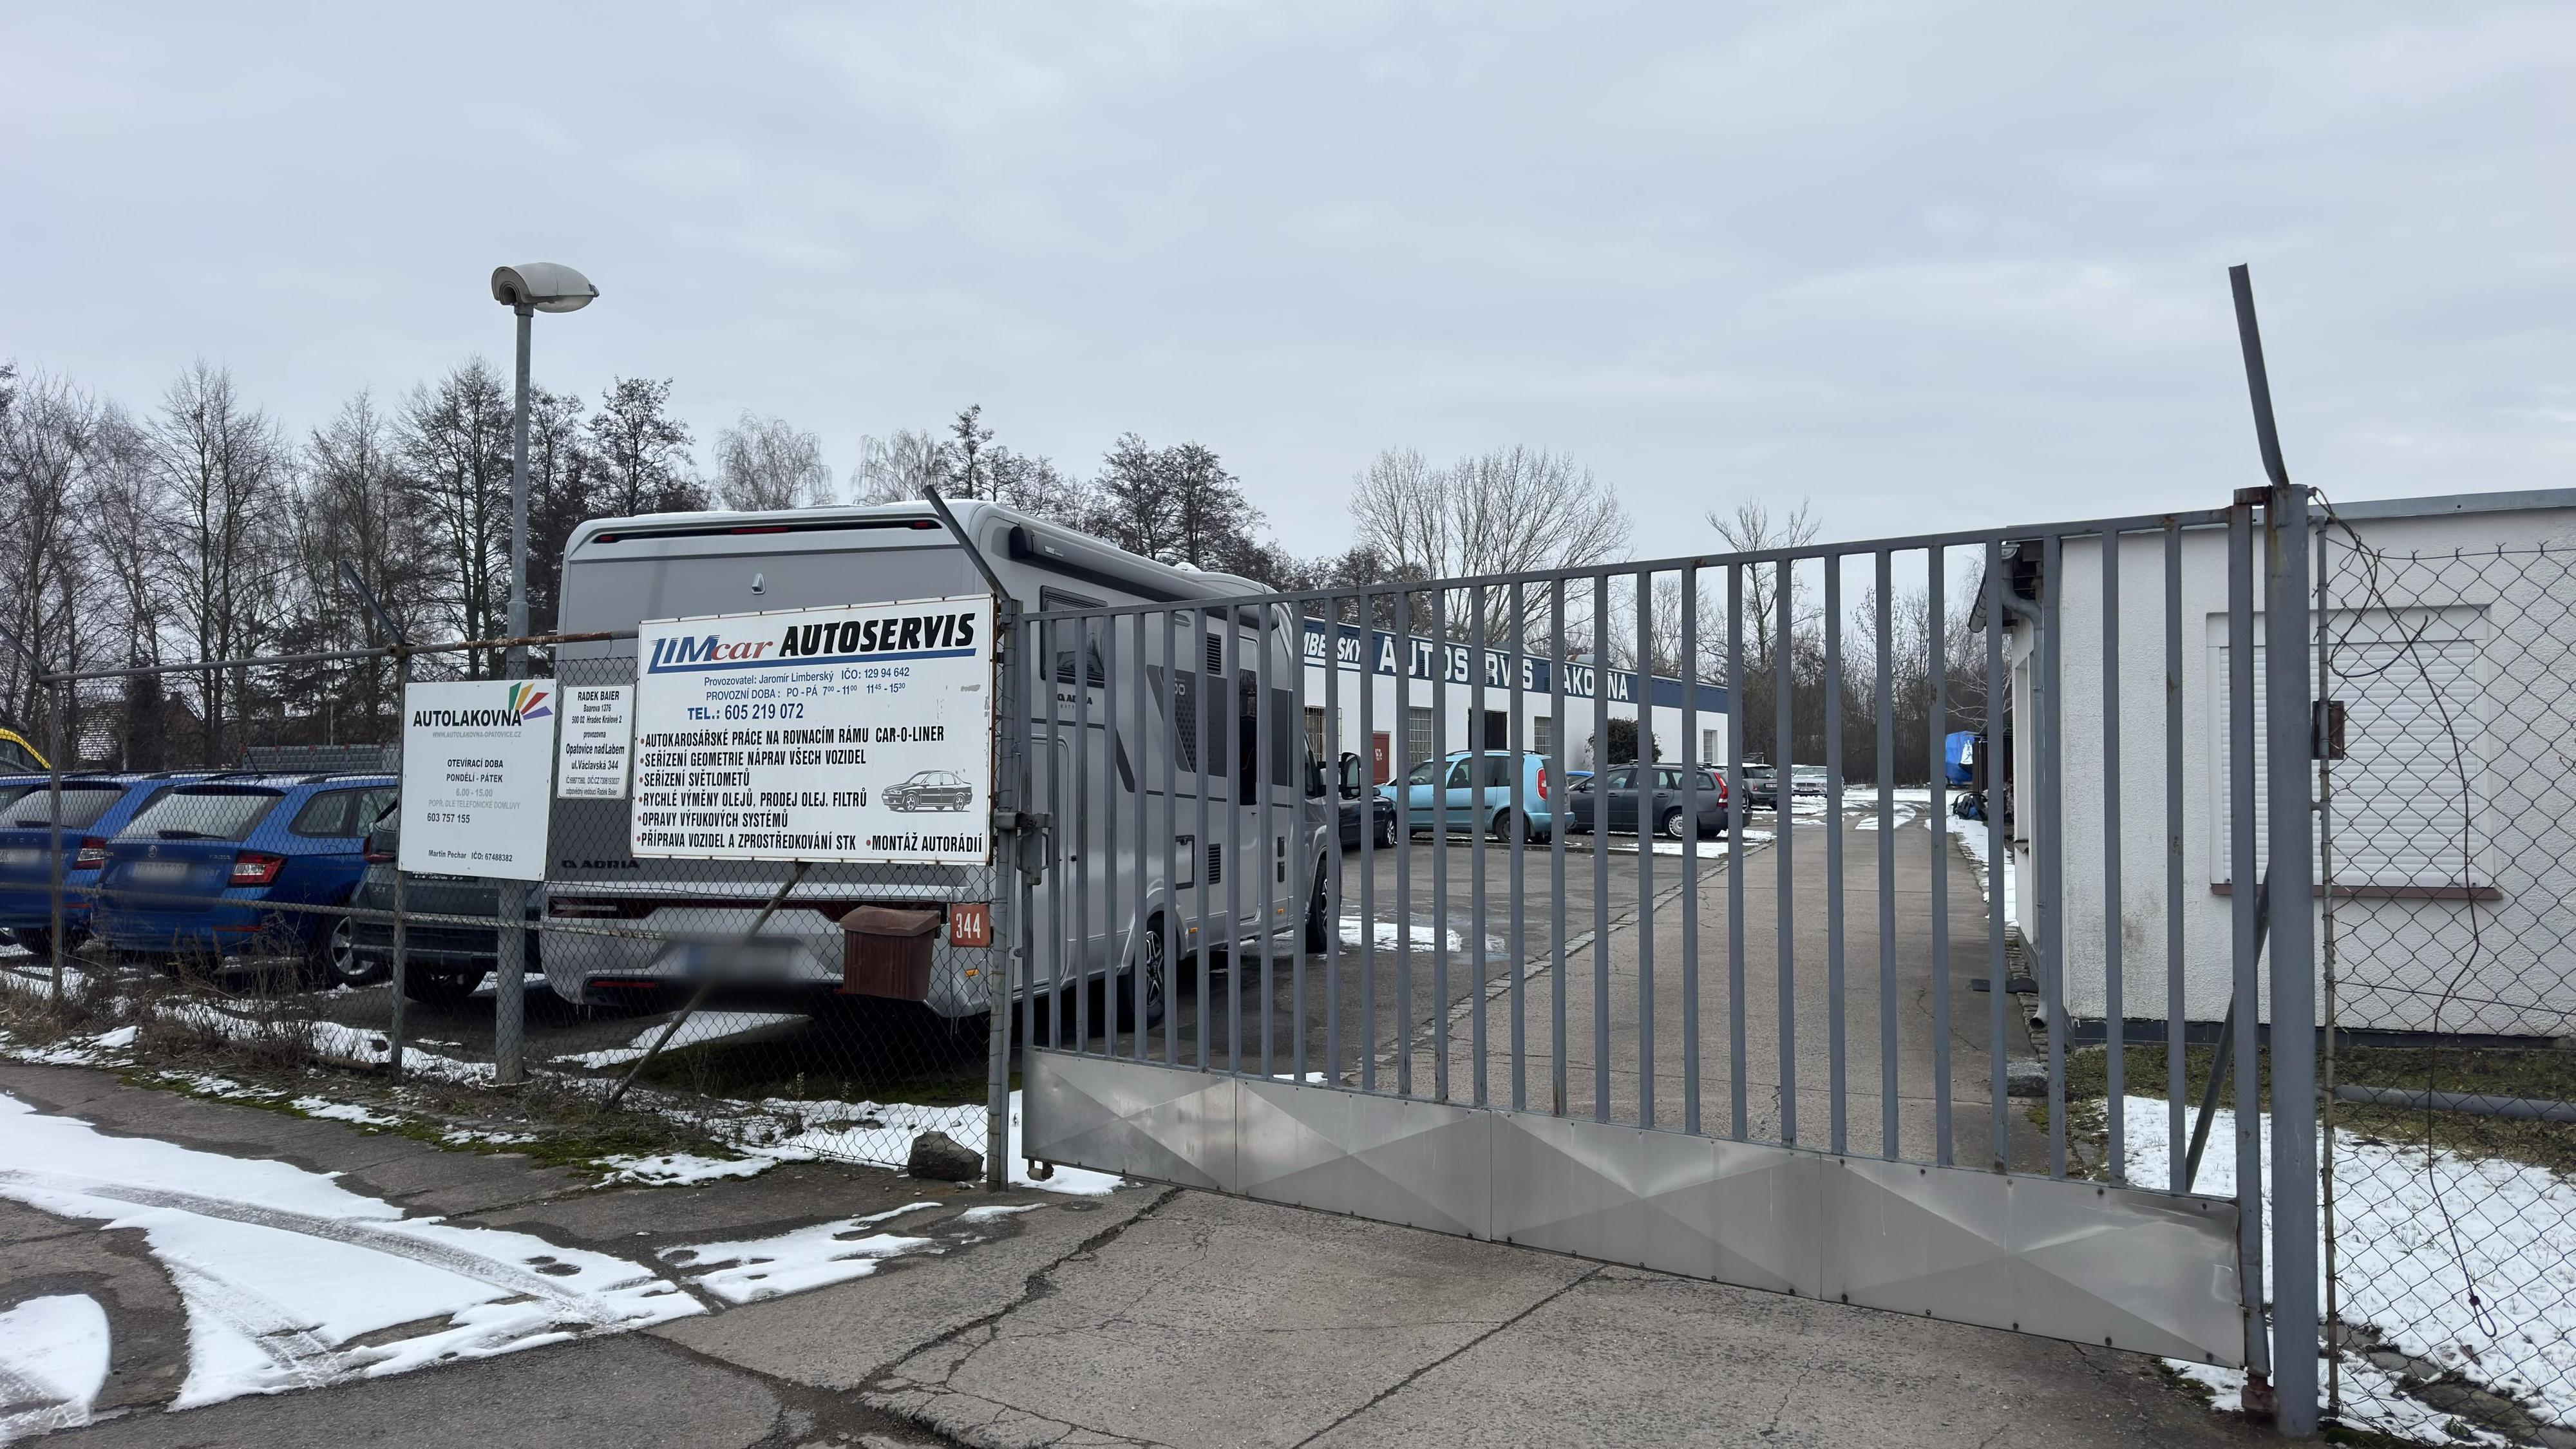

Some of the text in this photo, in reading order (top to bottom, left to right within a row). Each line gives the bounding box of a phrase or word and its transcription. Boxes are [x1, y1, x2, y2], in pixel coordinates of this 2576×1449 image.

[779, 612, 976, 657] AUTOSERVIS
[705, 667, 909, 686] Provozovatel: Jaromír Limberský IČO: 129 94 642
[1551, 662, 1629, 700] AKONA
[578, 690, 620, 701] RADEK BAIER
[706, 688, 749, 701] PROVOZNÍ
[752, 689, 776, 699] DOBA
[786, 687, 799, 697] PO
[806, 685, 818, 696] PÁ
[413, 710, 522, 726] AUTOLAKOVNA
[602, 715, 618, 723] Králové
[688, 703, 804, 720] TEL.: 605 219 072
[645, 725, 944, 747] AUTOKAROSÁŘSKÉ PRÁCE NA ROVNACÍM RÁMU CAR-O-LINER
[566, 743, 592, 757] Opatovice
[645, 747, 866, 766] SEŘÍZENÍ GEOMETRIE NÁPRAV VŠECH VOZIDEL
[448, 757, 504, 768] OTEVÍRACÍ DOBA
[607, 760, 618, 770] 344
[446, 772, 474, 782] PONDĚLÍ
[480, 772, 502, 782] PÁTEK
[644, 768, 750, 786] SEŘÍZENÍ SVĚTLOMETŮ
[456, 788, 469, 797] 6.00
[644, 788, 867, 808] RYCHLÉ VÝMĚNY OLEJŮ, PRODEJ OLEJ. FILTRŮ
[427, 813, 470, 823] 603 757 155
[643, 808, 788, 828] OPRAVY VÝFUKOVÝCH SYSTÉMŮ
[641, 829, 856, 850] PŘÍPRAVA VOZIDEL A ZPROSTŘEDKOVÁNÍ STK
[872, 832, 982, 853] MONTÁŽ AUTORÁDIÍ
[471, 851, 483, 860] IČO:
[485, 853, 513, 862] 67488382
[956, 913, 981, 938] 344
